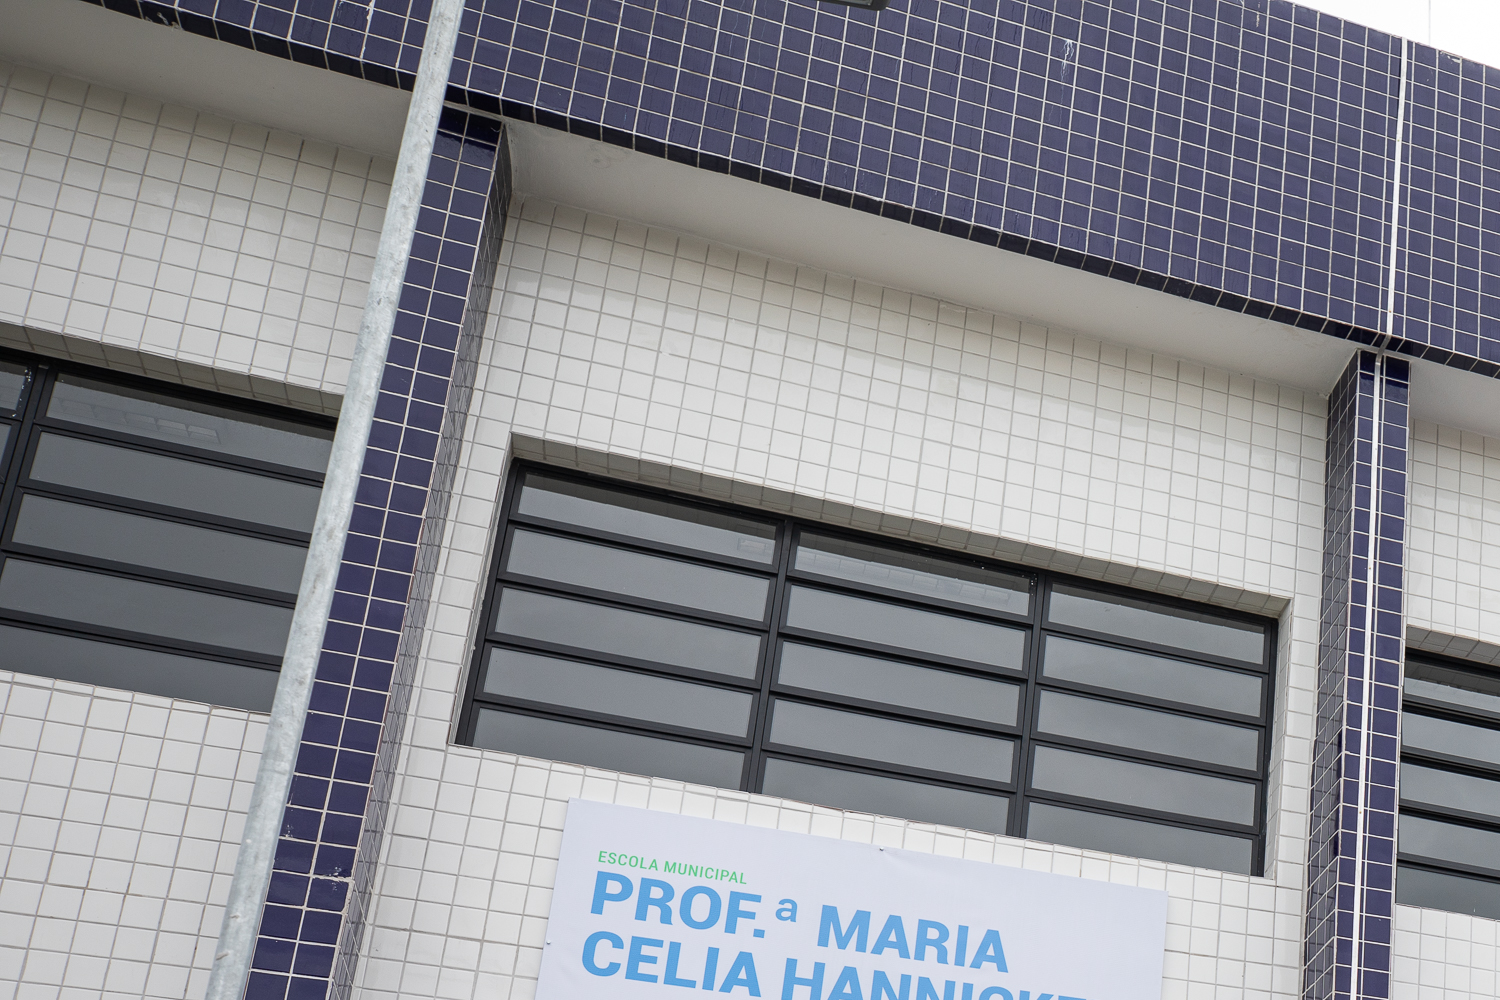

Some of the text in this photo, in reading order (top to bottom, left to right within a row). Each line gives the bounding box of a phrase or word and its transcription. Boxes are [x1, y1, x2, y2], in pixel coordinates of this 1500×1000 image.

[597, 850, 748, 885] ESCOLA MUNICIPAL
[581, 930, 762, 998] CELIA
[817, 904, 1009, 974] MARIA
